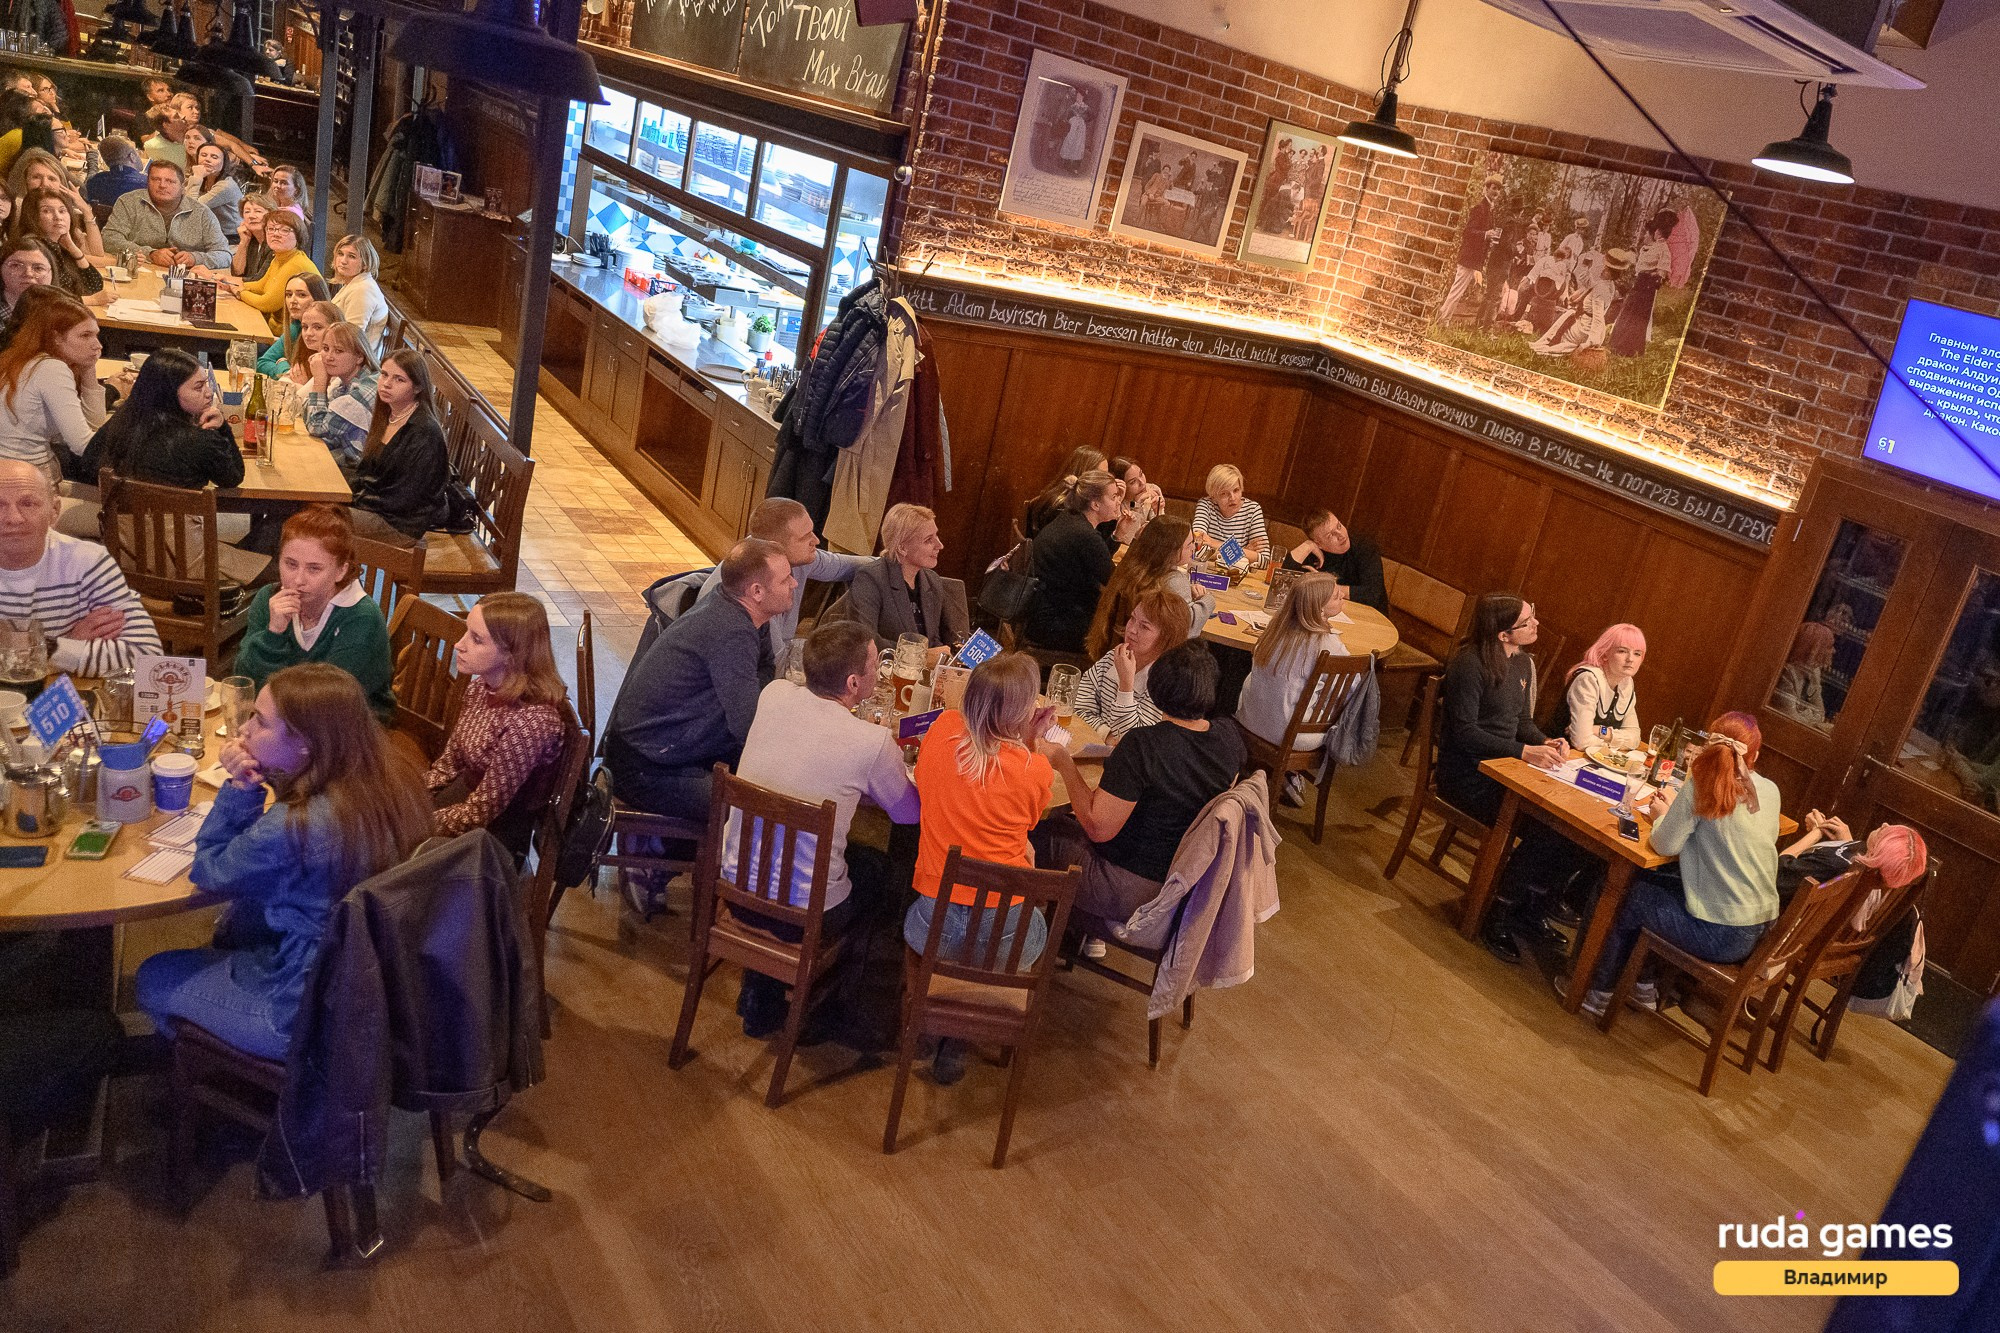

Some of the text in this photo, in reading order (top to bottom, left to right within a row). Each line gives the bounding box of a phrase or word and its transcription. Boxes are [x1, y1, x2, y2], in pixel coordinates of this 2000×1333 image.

[802, 48, 841, 89] Max
[943, 292, 985, 318] Adam
[1053, 310, 1083, 333] Bier
[1086, 316, 1138, 341] besessen
[1182, 332, 1203, 352] den
[1929, 332, 1979, 353] Главным
[1916, 356, 2000, 386] дракон Алдуи
[1940, 347, 1961, 361] The
[1962, 354, 1994, 370] Elder
[1906, 366, 1984, 393] сподвижника
[1908, 378, 1974, 403] выражения
[1971, 420, 2000, 437] Како
[1482, 420, 1524, 447] ПИВА
[1528, 436, 1541, 451] В
[1619, 472, 1680, 506] ПОГРЯЗ
[1683, 496, 1711, 518] БЫ
[1712, 505, 1727, 523] В
[966, 645, 986, 665] 505
[40, 702, 70, 735] 510
